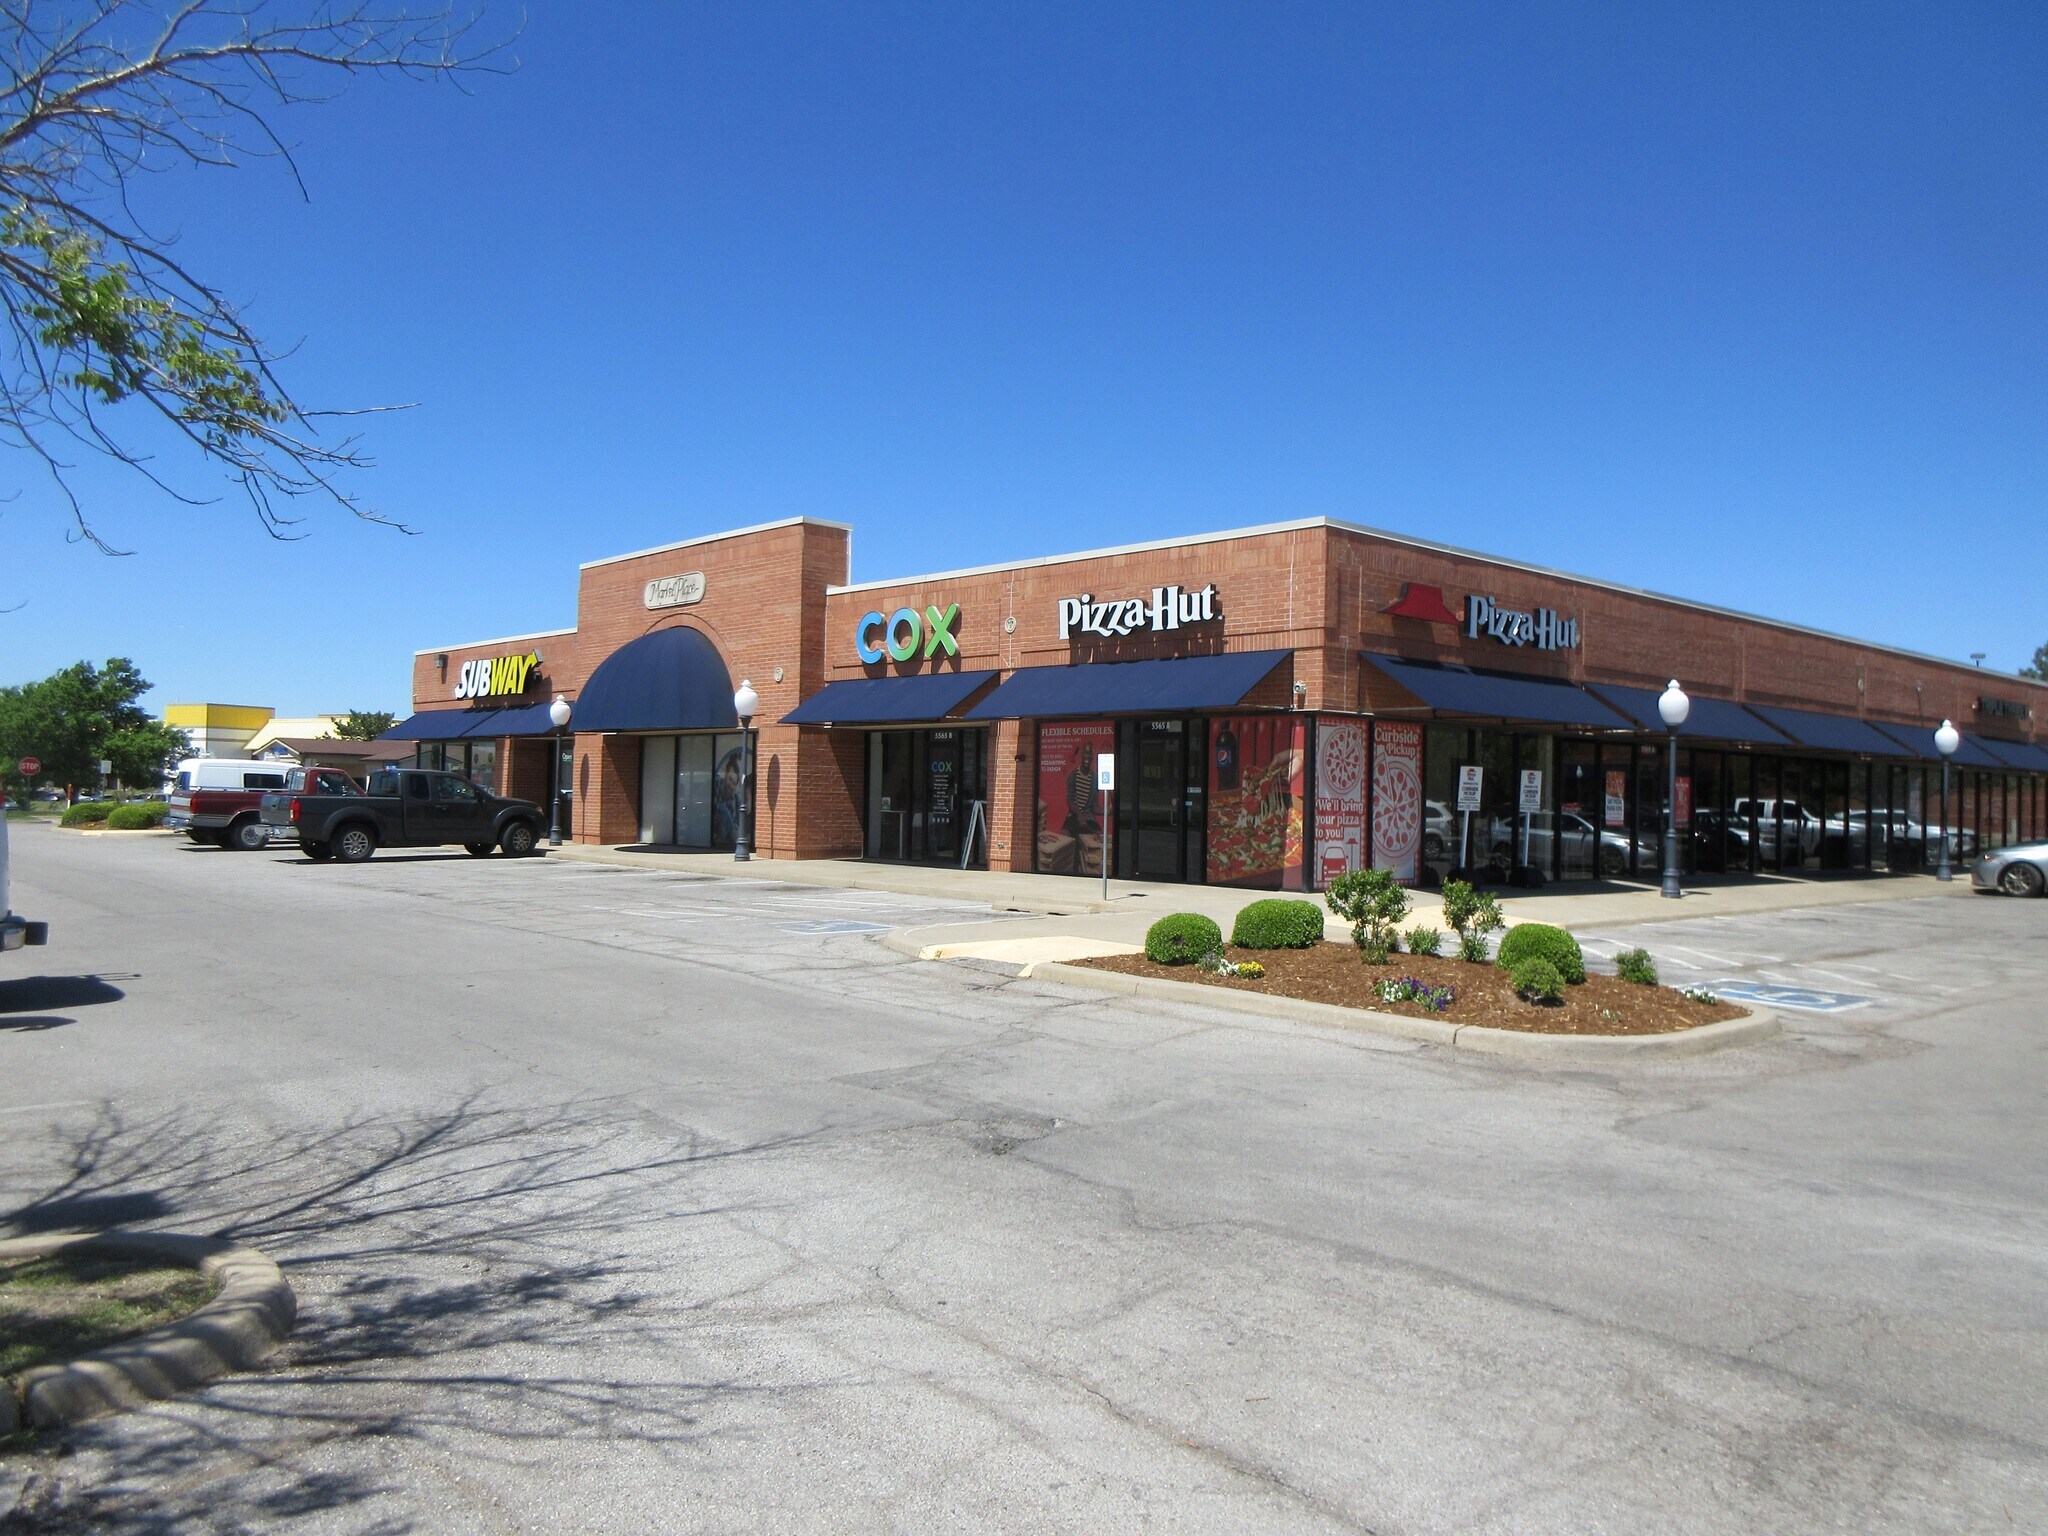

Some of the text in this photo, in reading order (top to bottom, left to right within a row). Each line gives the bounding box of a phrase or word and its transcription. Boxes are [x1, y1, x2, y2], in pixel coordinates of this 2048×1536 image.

[1058, 593, 1145, 640] Pizza
[1467, 594, 1535, 648] Pizza
[856, 602, 961, 665] COX
[455, 650, 540, 699] SUBWAY
[1041, 726, 1115, 736] FLEXIBLE SCHEDULES.
[1374, 728, 1419, 744] Curbside
[1385, 744, 1416, 759] Pickup
[931, 761, 953, 772] COX
[1315, 799, 1364, 813] We'll bring
[1315, 814, 1360, 828] your pizza
[1315, 827, 1344, 840] to you!
